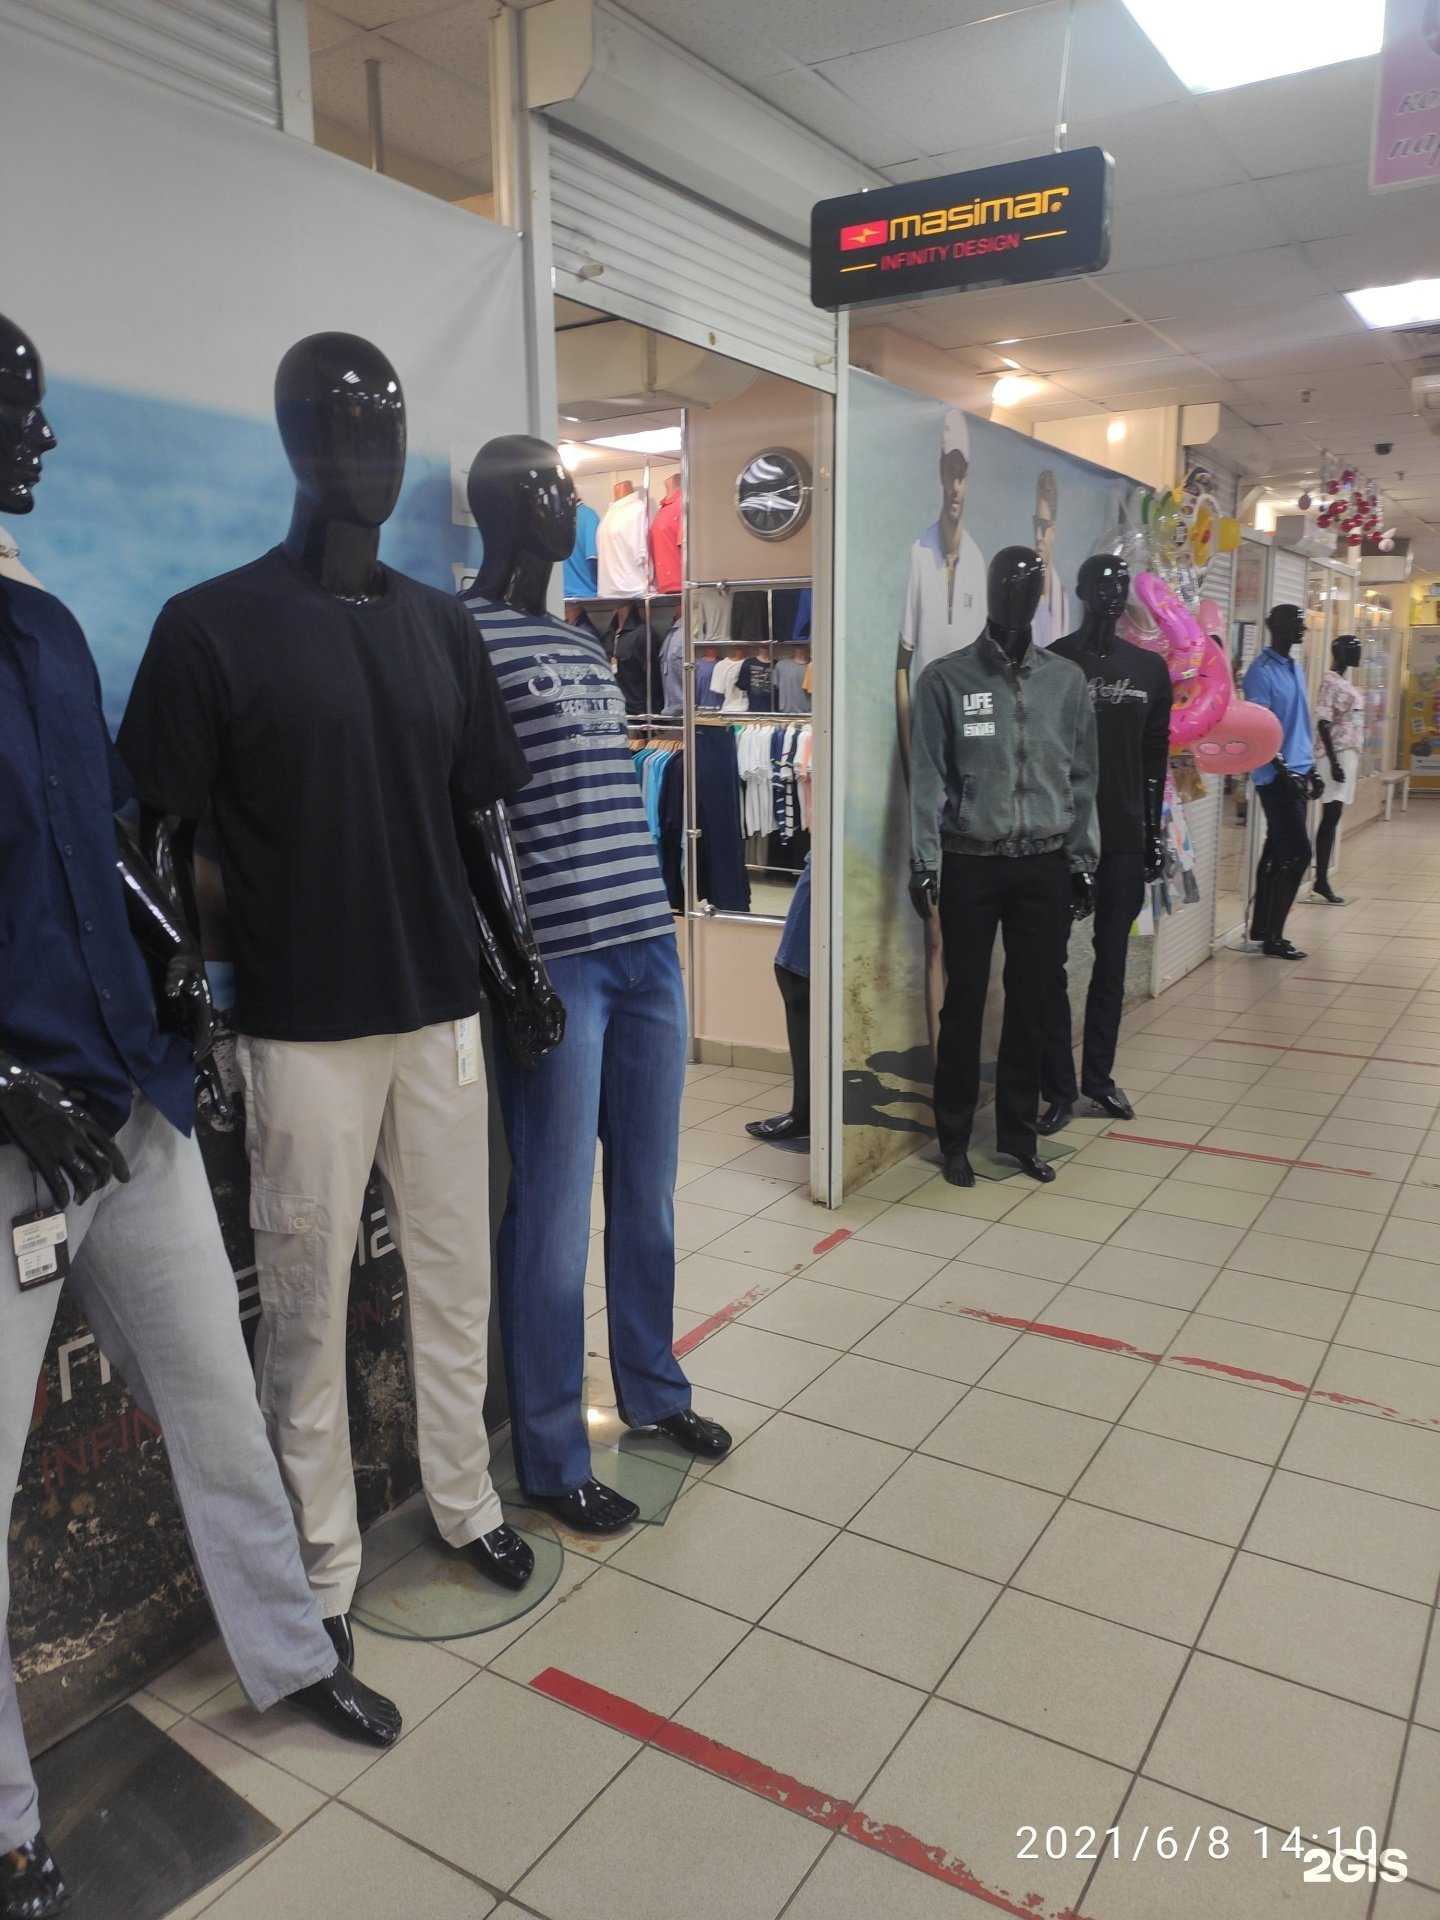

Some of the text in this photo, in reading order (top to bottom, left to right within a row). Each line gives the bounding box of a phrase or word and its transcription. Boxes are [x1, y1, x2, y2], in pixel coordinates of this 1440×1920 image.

[880, 232, 1020, 272] INFINITY DESIGN
[38, 1407, 163, 1488] INFIN
